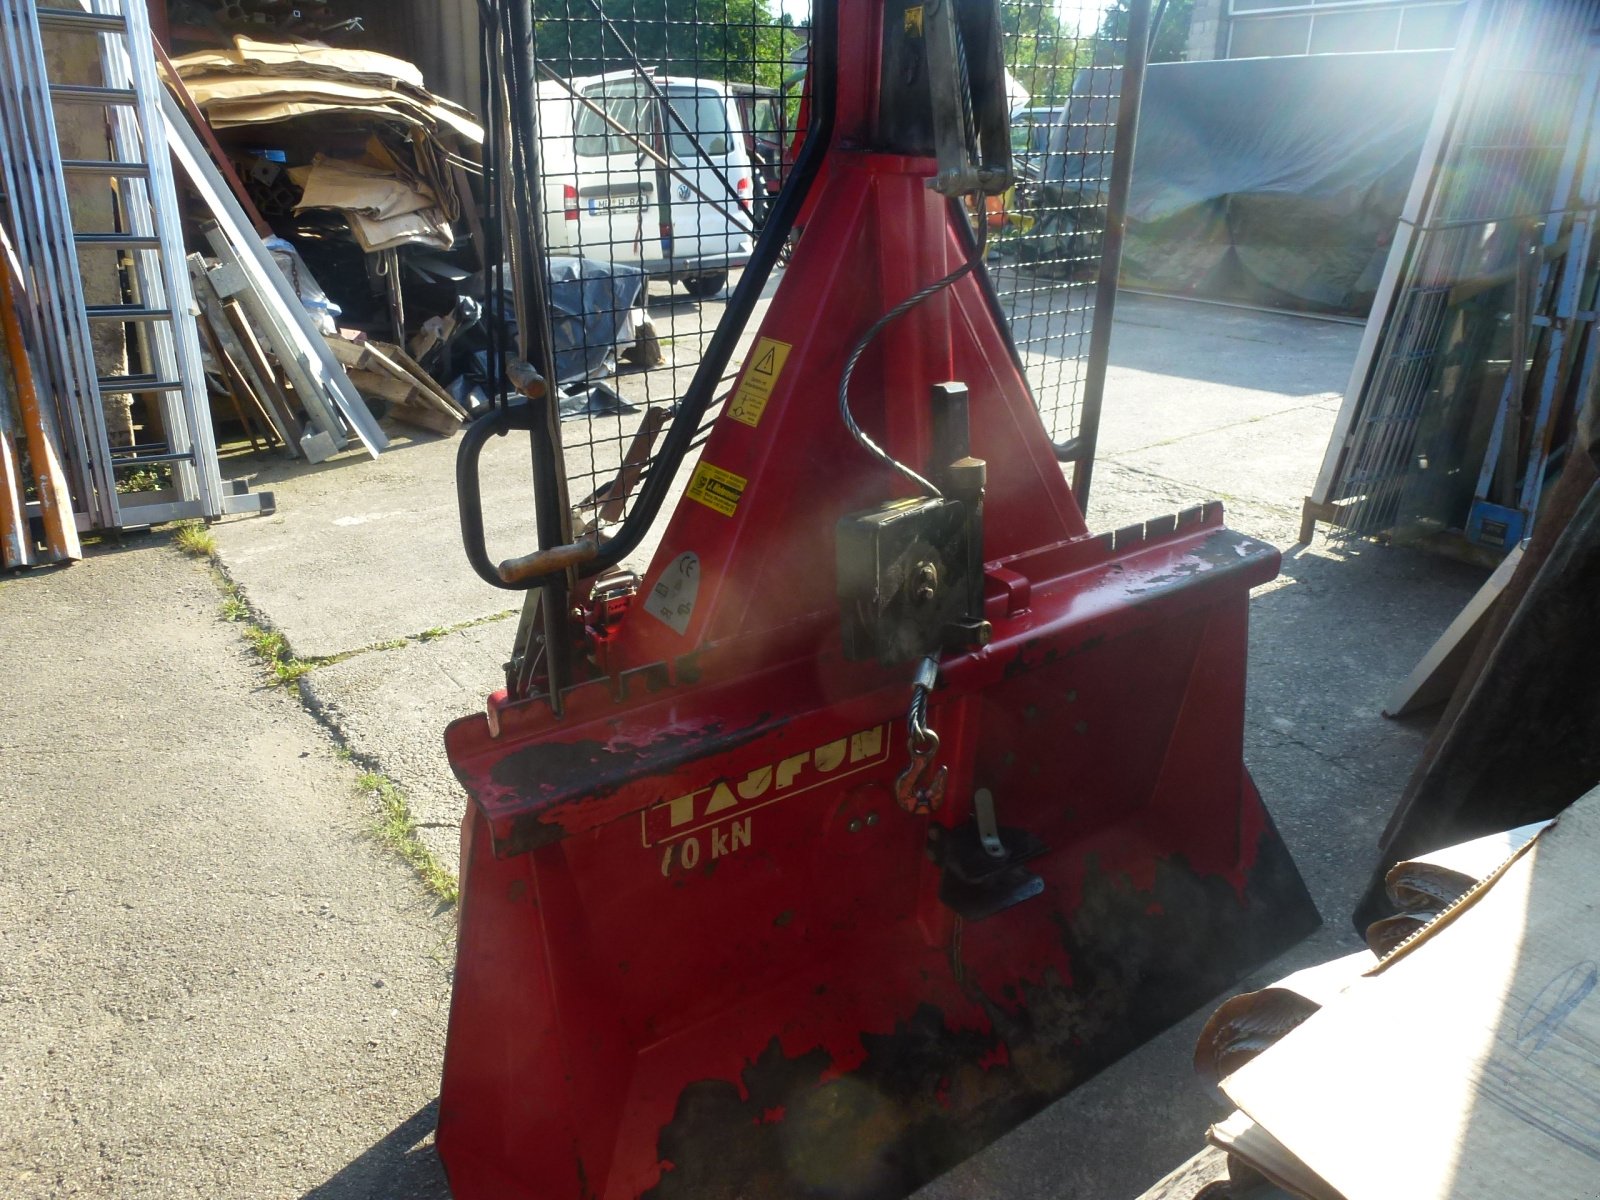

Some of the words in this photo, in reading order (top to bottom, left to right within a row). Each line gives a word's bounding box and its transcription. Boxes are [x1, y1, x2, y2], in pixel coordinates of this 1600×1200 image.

[680, 556, 697, 578] CE
[653, 726, 882, 828] TAJFUN
[711, 816, 752, 860] kN
